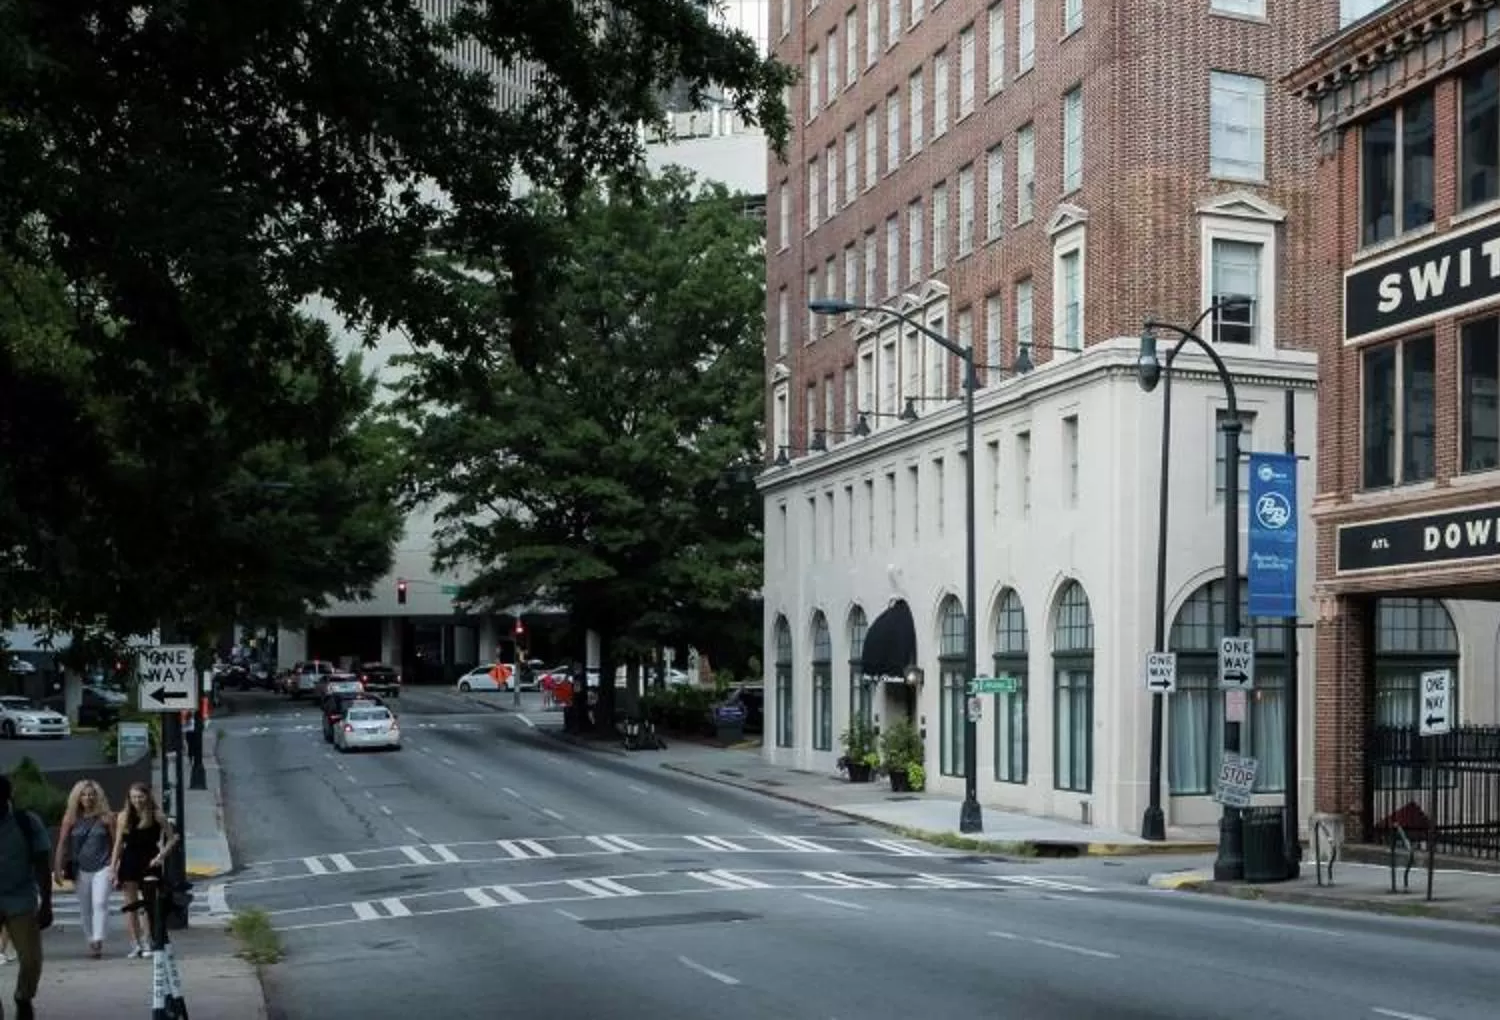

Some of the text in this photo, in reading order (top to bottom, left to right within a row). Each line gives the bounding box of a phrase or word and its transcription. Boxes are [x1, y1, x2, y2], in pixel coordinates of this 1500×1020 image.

[1371, 537, 1390, 549] ATL
[1223, 641, 1250, 654] ONE
[149, 650, 187, 665] ONE
[1149, 655, 1173, 666] ONE
[1223, 657, 1250, 669] WAY
[147, 667, 188, 682] WAY
[1149, 667, 1173, 678] WAY
[1426, 676, 1445, 692] ONE
[1425, 695, 1445, 710] WAY
[1221, 764, 1253, 786] STOP
